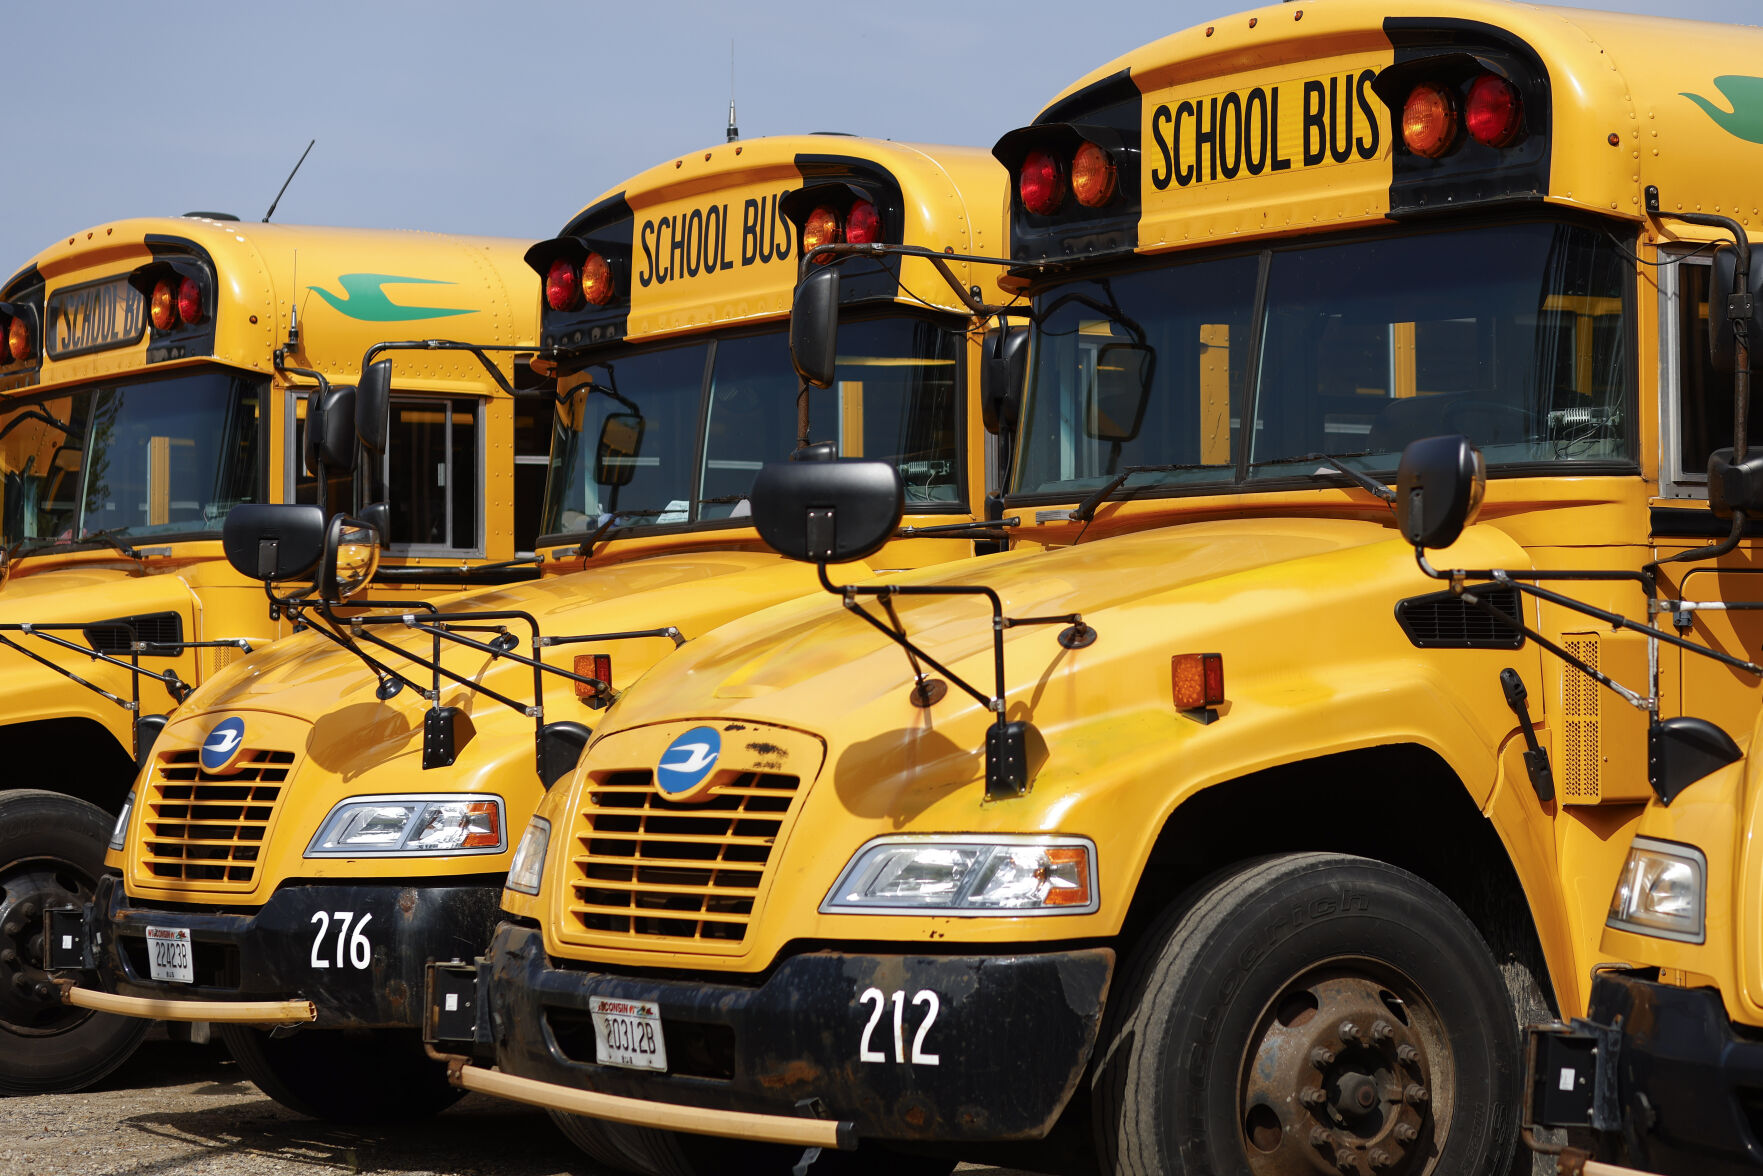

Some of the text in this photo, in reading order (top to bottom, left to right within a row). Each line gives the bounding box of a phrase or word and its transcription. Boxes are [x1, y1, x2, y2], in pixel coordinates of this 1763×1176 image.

[1151, 69, 1380, 191] SCHOOL BUS
[639, 190, 792, 288] SCHOOL BUS
[61, 284, 147, 350] SCHOOL BU
[155, 941, 187, 969] 22423B
[310, 910, 373, 970] 276
[604, 1018, 656, 1054] 20312B
[859, 987, 940, 1066] 212
